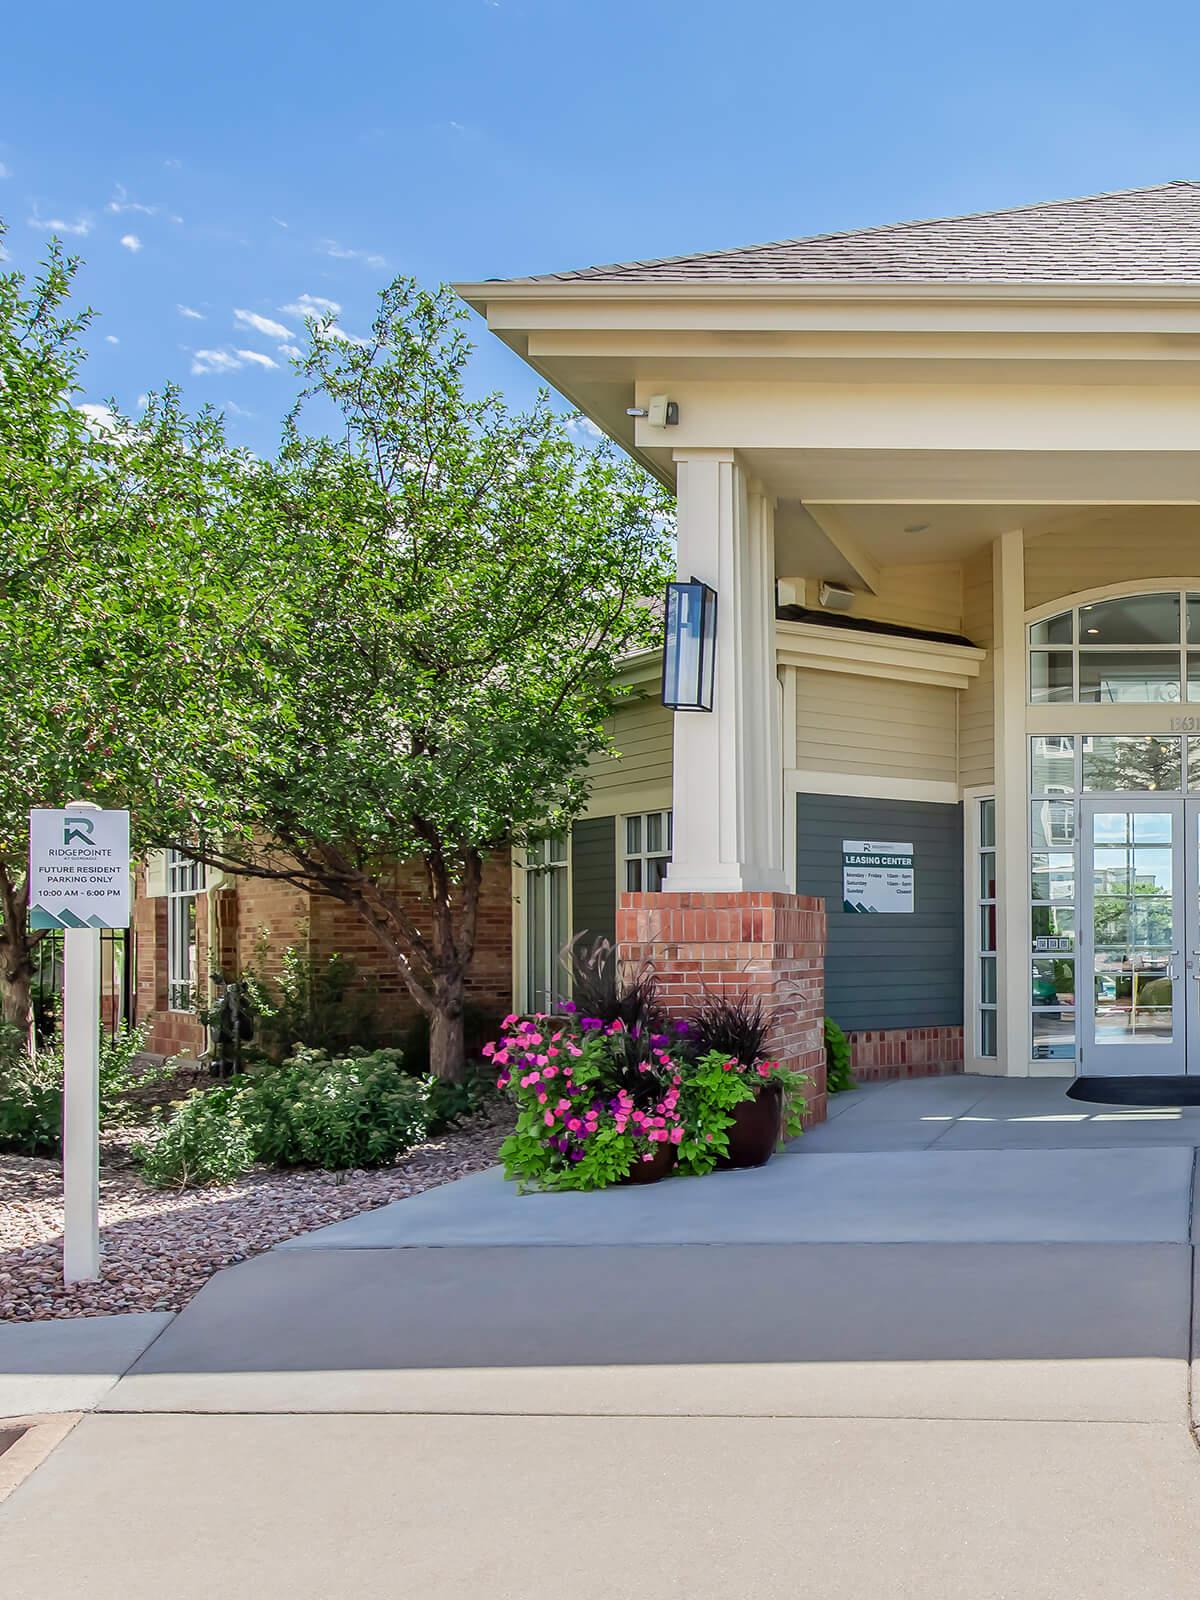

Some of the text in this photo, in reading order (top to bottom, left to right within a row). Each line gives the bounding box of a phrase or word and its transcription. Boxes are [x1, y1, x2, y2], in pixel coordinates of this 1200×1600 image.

[48, 849, 112, 857] RIDGEPOINTE
[845, 856, 912, 865] LEASING CENTER
